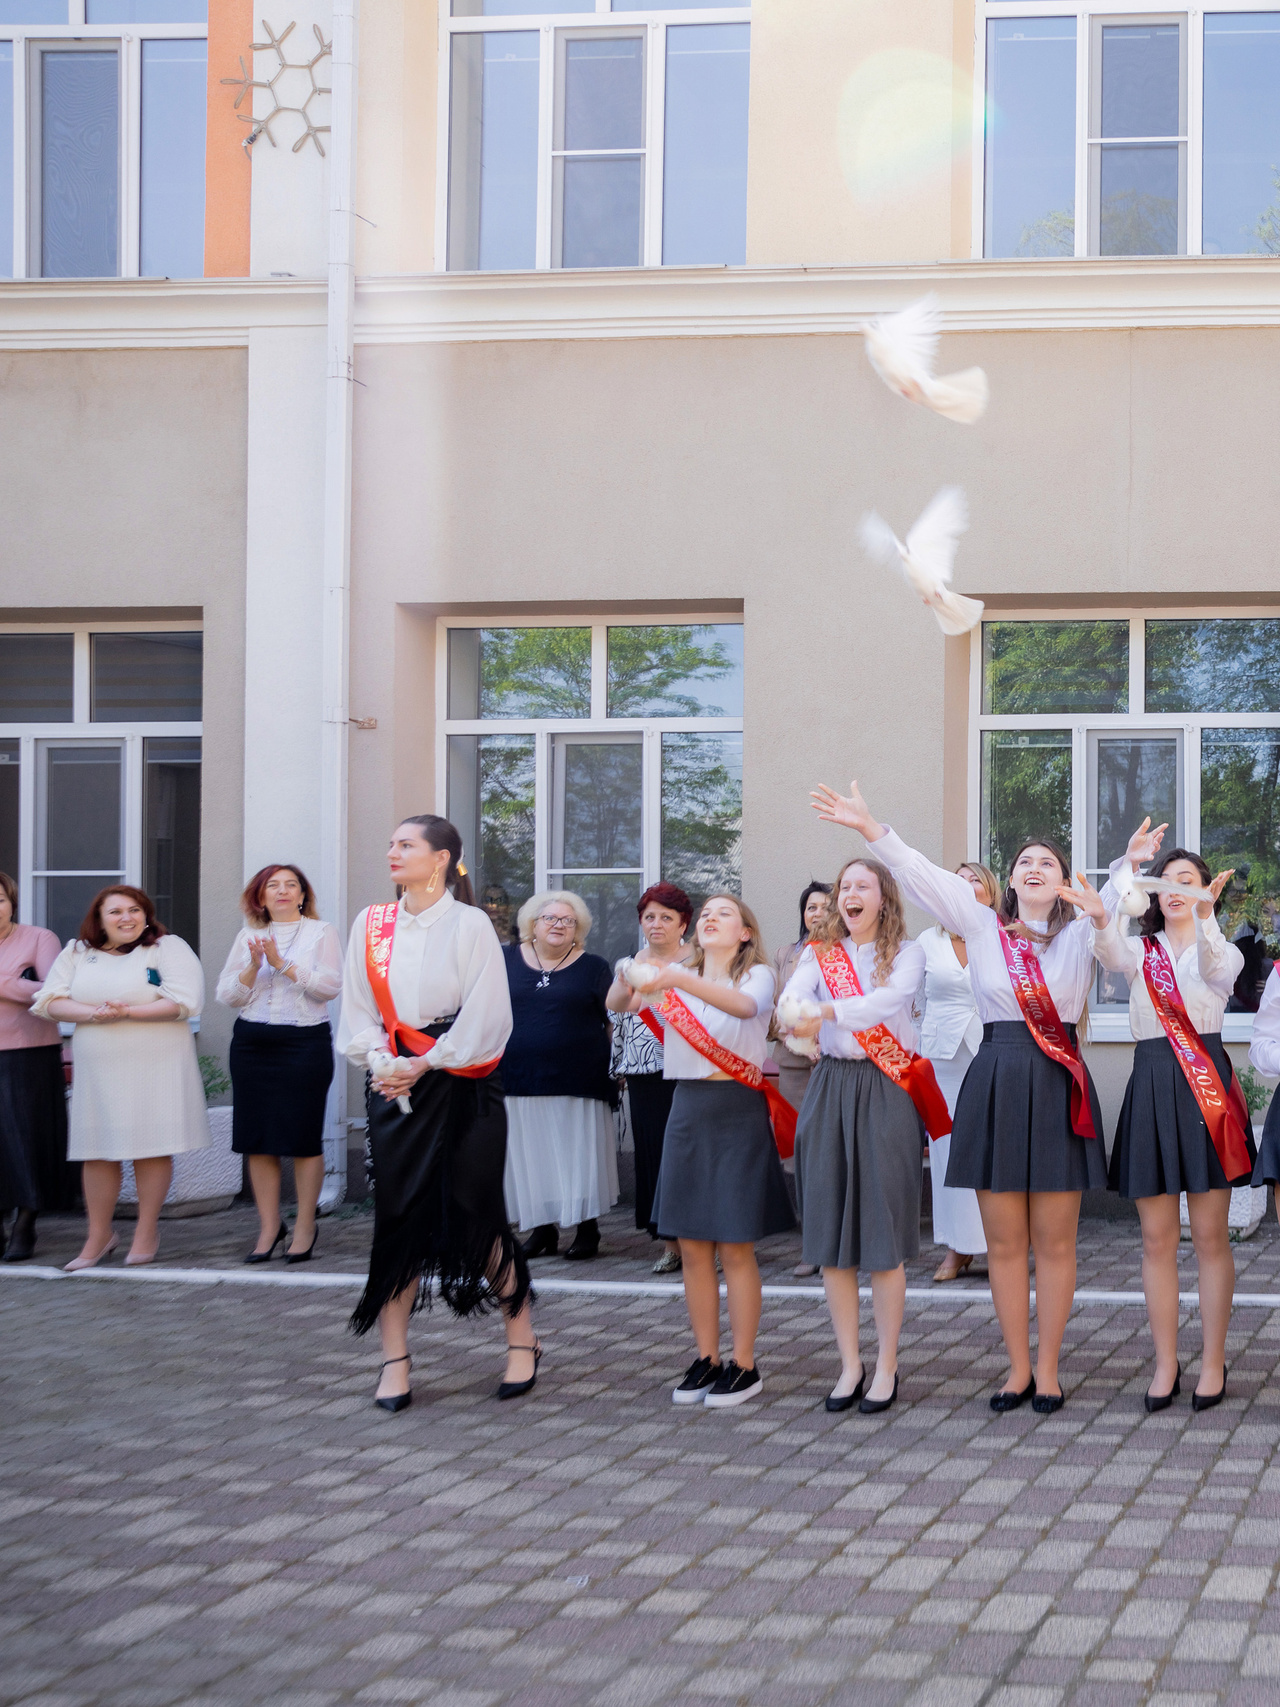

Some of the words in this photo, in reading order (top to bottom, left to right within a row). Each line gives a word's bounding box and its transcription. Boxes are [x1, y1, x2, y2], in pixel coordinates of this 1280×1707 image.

[1007, 934, 1043, 1020] Выпускница
[867, 1034, 911, 1076] 2022
[1151, 969, 1195, 1062] Выпускница
[1191, 1065, 1221, 1106] 2022
